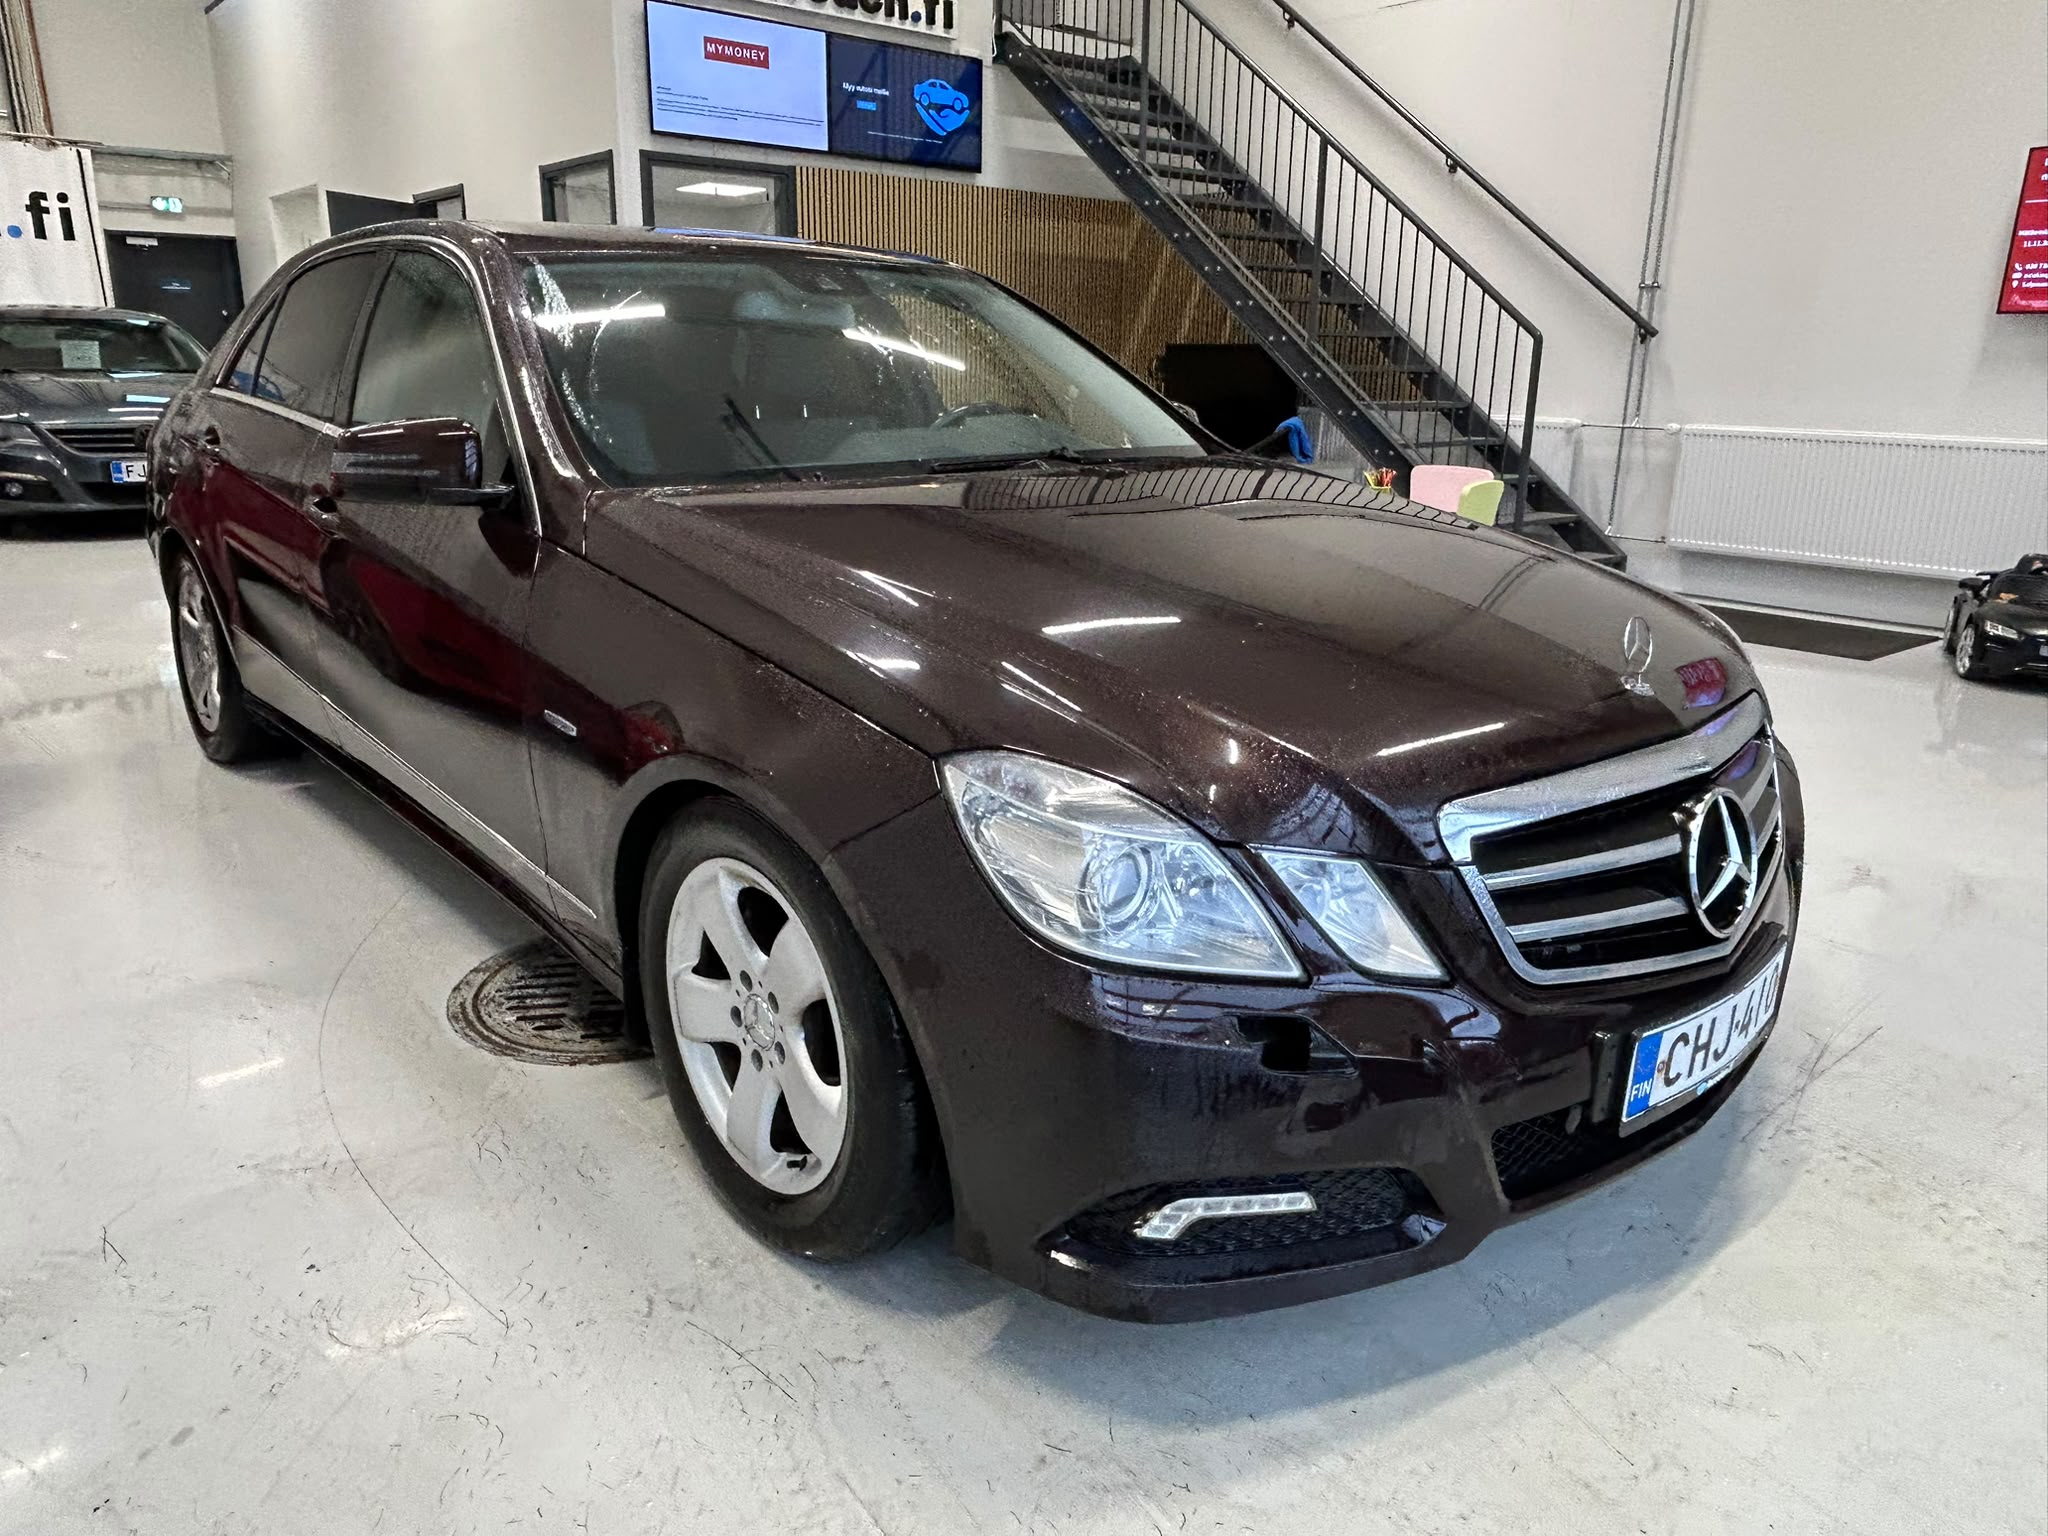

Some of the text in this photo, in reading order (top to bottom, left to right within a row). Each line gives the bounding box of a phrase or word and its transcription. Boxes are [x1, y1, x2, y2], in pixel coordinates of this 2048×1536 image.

[706, 42, 765, 61] MYMONEY
[0, 191, 76, 241] .fi
[1663, 962, 1779, 1088] CHJ-410
[1630, 1078, 1653, 1102] FIN
